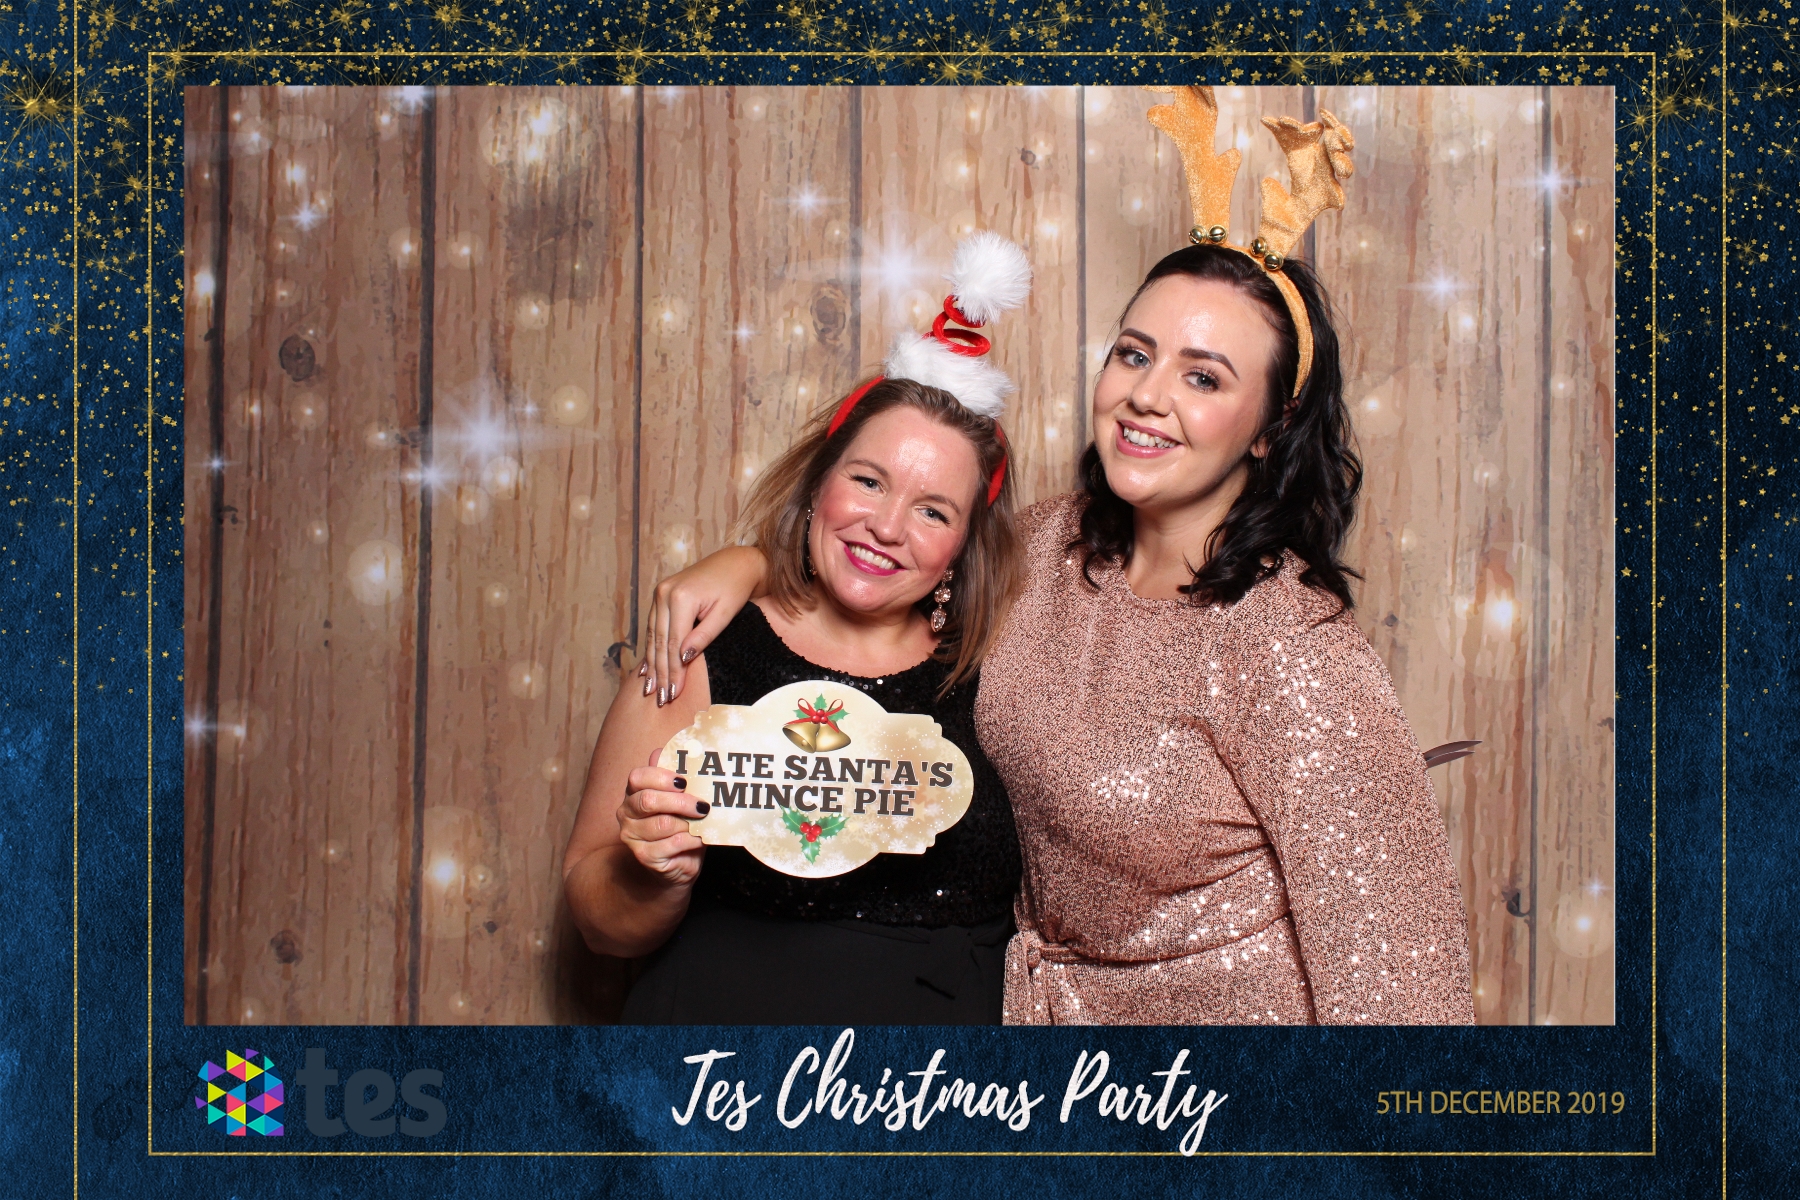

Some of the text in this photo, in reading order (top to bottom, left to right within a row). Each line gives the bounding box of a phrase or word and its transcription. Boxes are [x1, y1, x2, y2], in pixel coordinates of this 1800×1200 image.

[675, 749, 954, 787] I ATE SANTA'S
[711, 780, 915, 817] MINCE PIE
